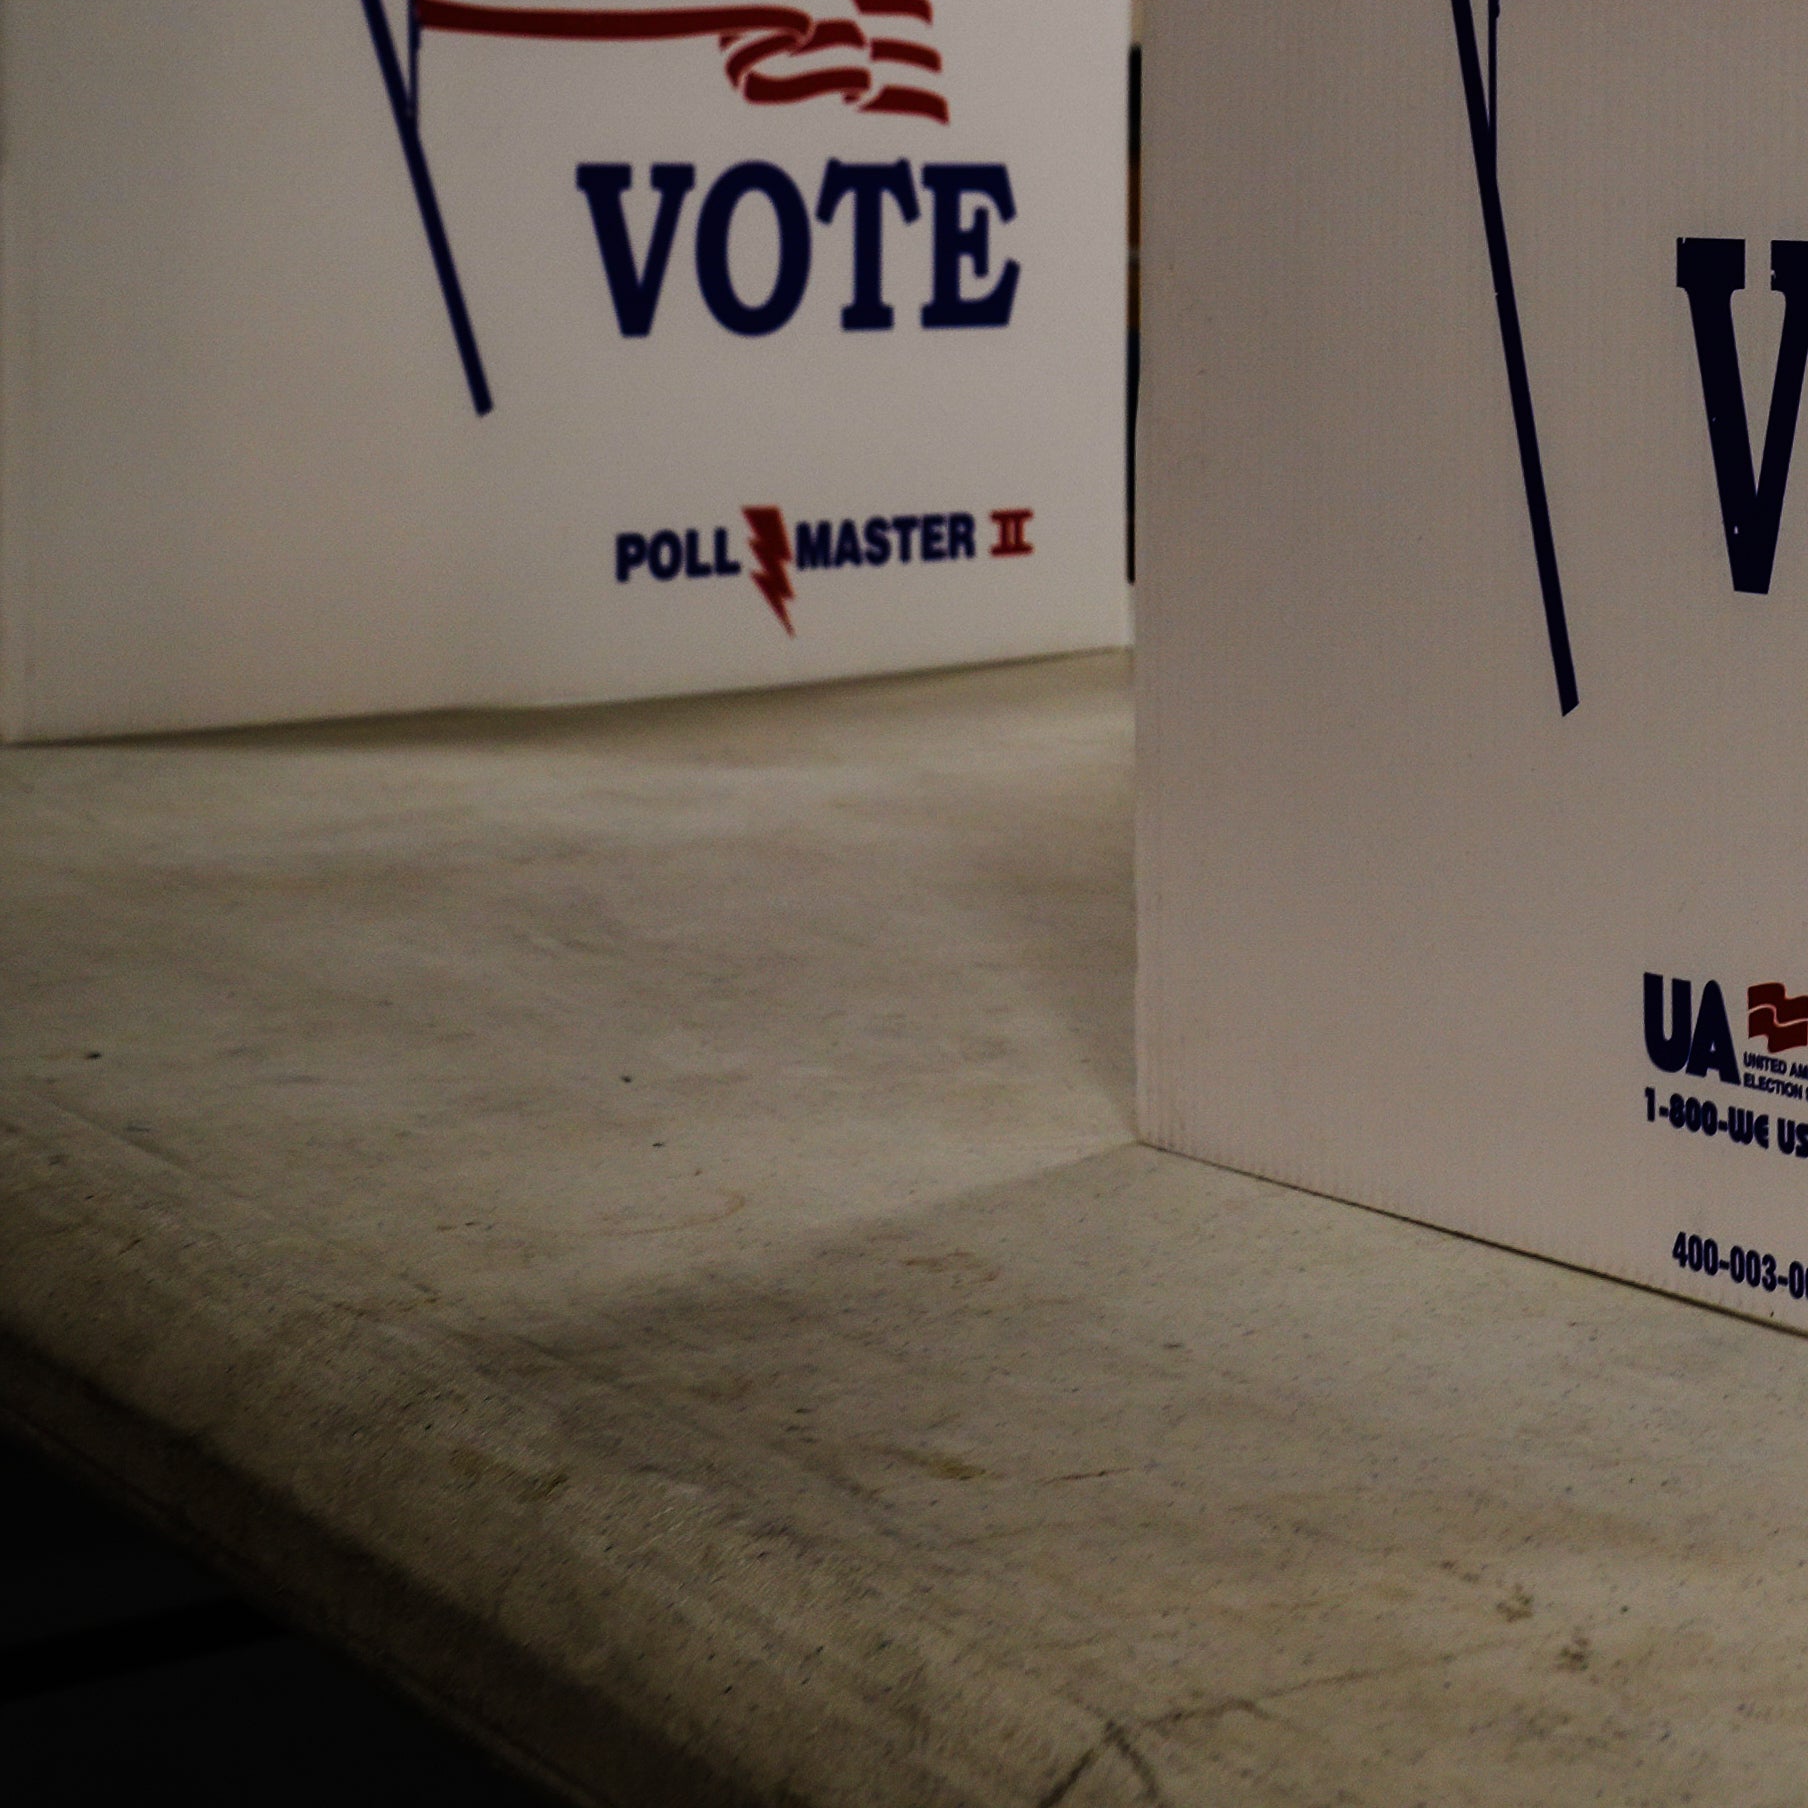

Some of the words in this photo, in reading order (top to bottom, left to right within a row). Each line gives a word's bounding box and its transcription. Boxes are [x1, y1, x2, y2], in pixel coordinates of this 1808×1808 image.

[574, 156, 1021, 339] VOTE
[615, 526, 741, 583] POLL
[794, 512, 976, 571] MASTER
[1643, 971, 1741, 1086] UA
[1743, 1050, 1788, 1075] UNITED
[1743, 1072, 1803, 1100] ELECTION
[1644, 1086, 1770, 1150] 1-800-WE
